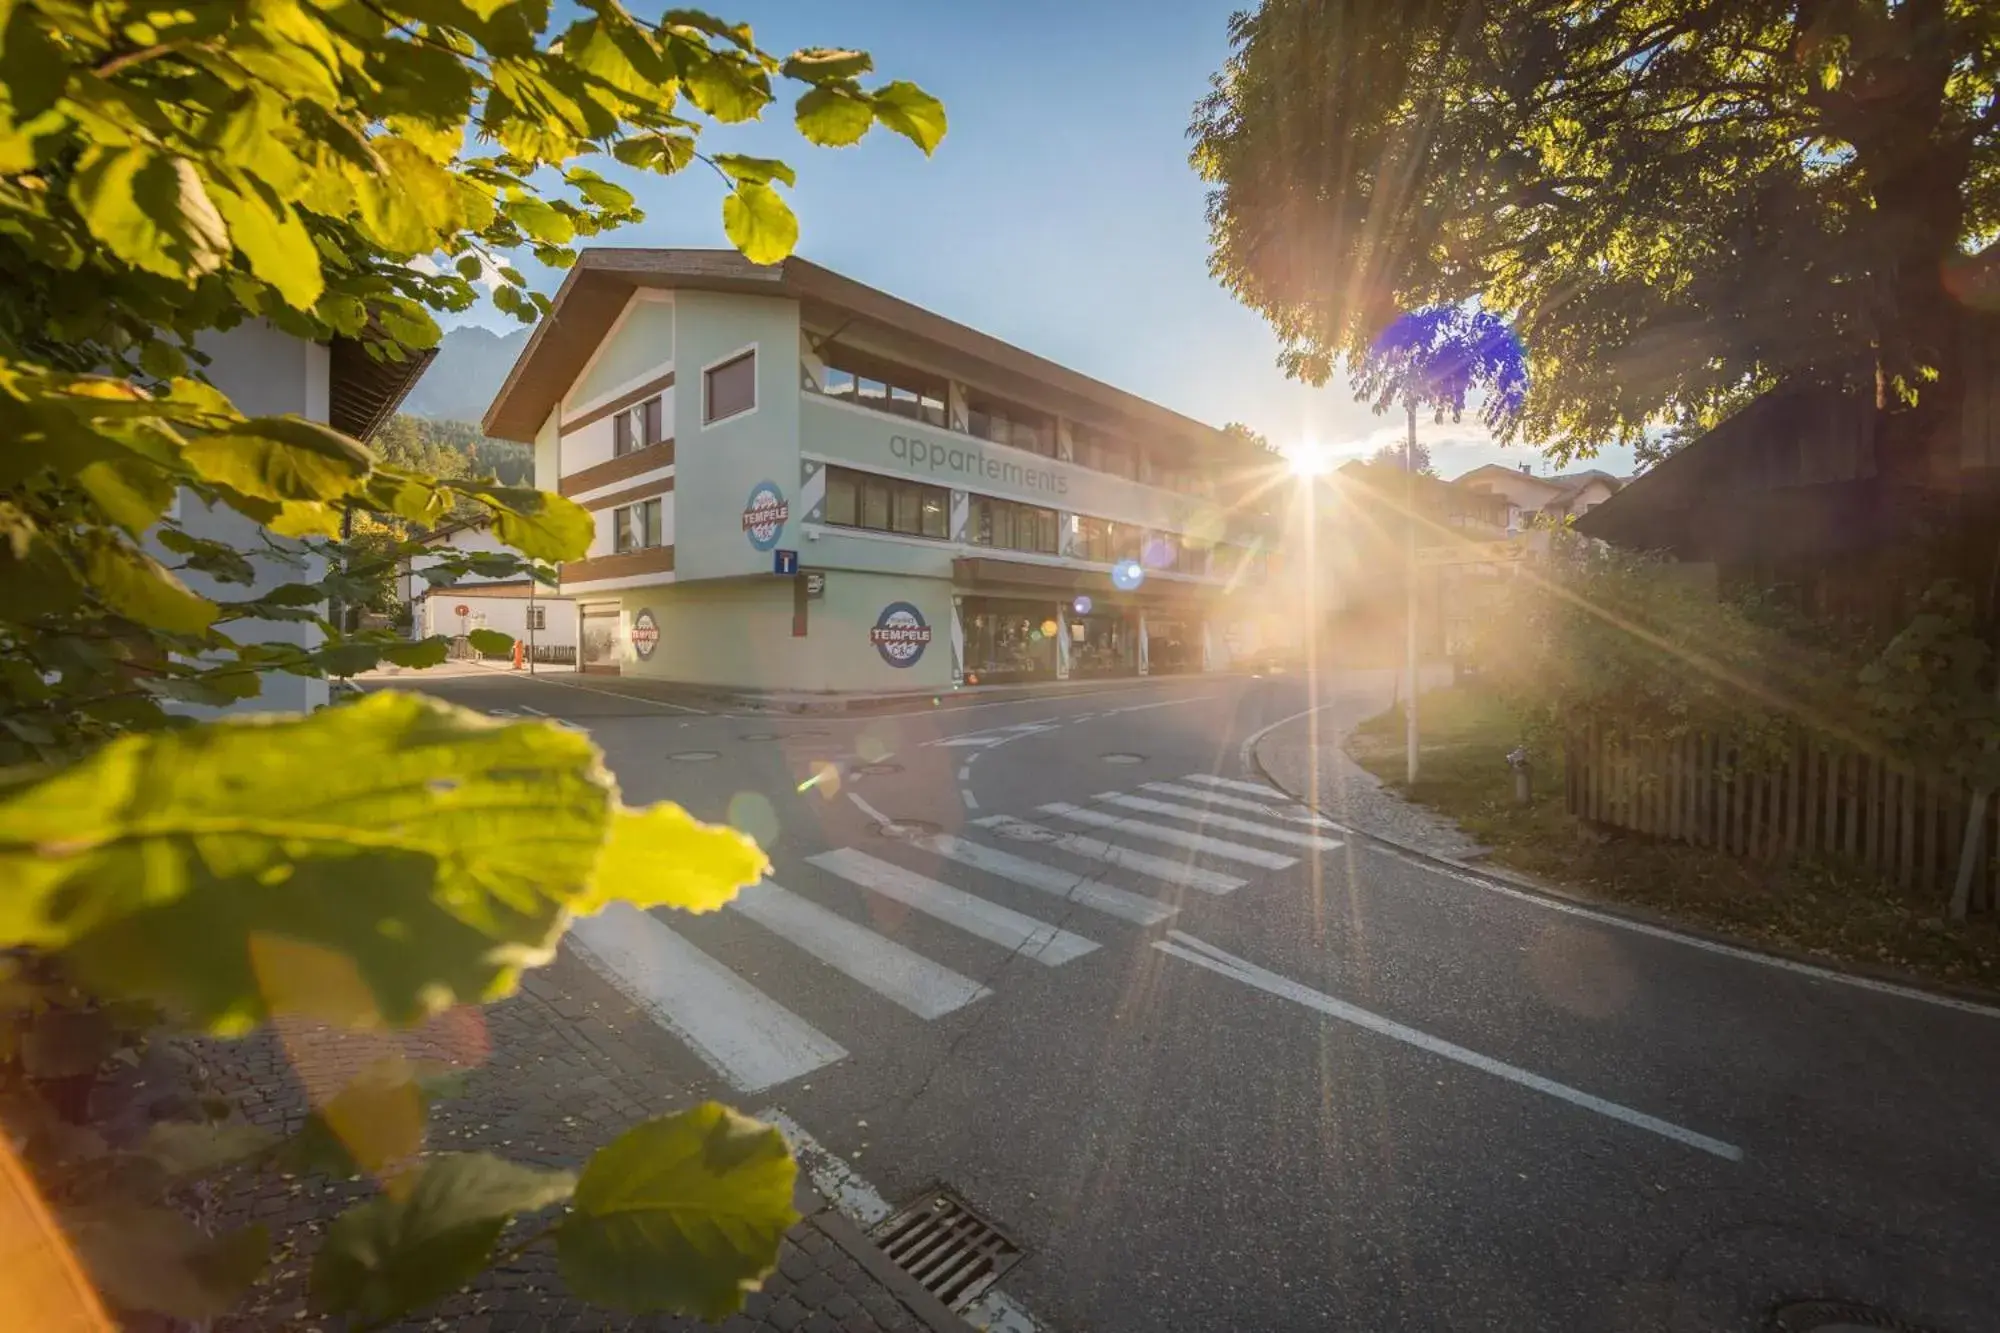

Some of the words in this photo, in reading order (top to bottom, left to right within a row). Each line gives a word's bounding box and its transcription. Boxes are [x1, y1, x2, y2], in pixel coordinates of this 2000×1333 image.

[889, 434, 1069, 495] appartements
[743, 506, 788, 525] TEMPELE
[873, 629, 930, 641] TEMPELE
